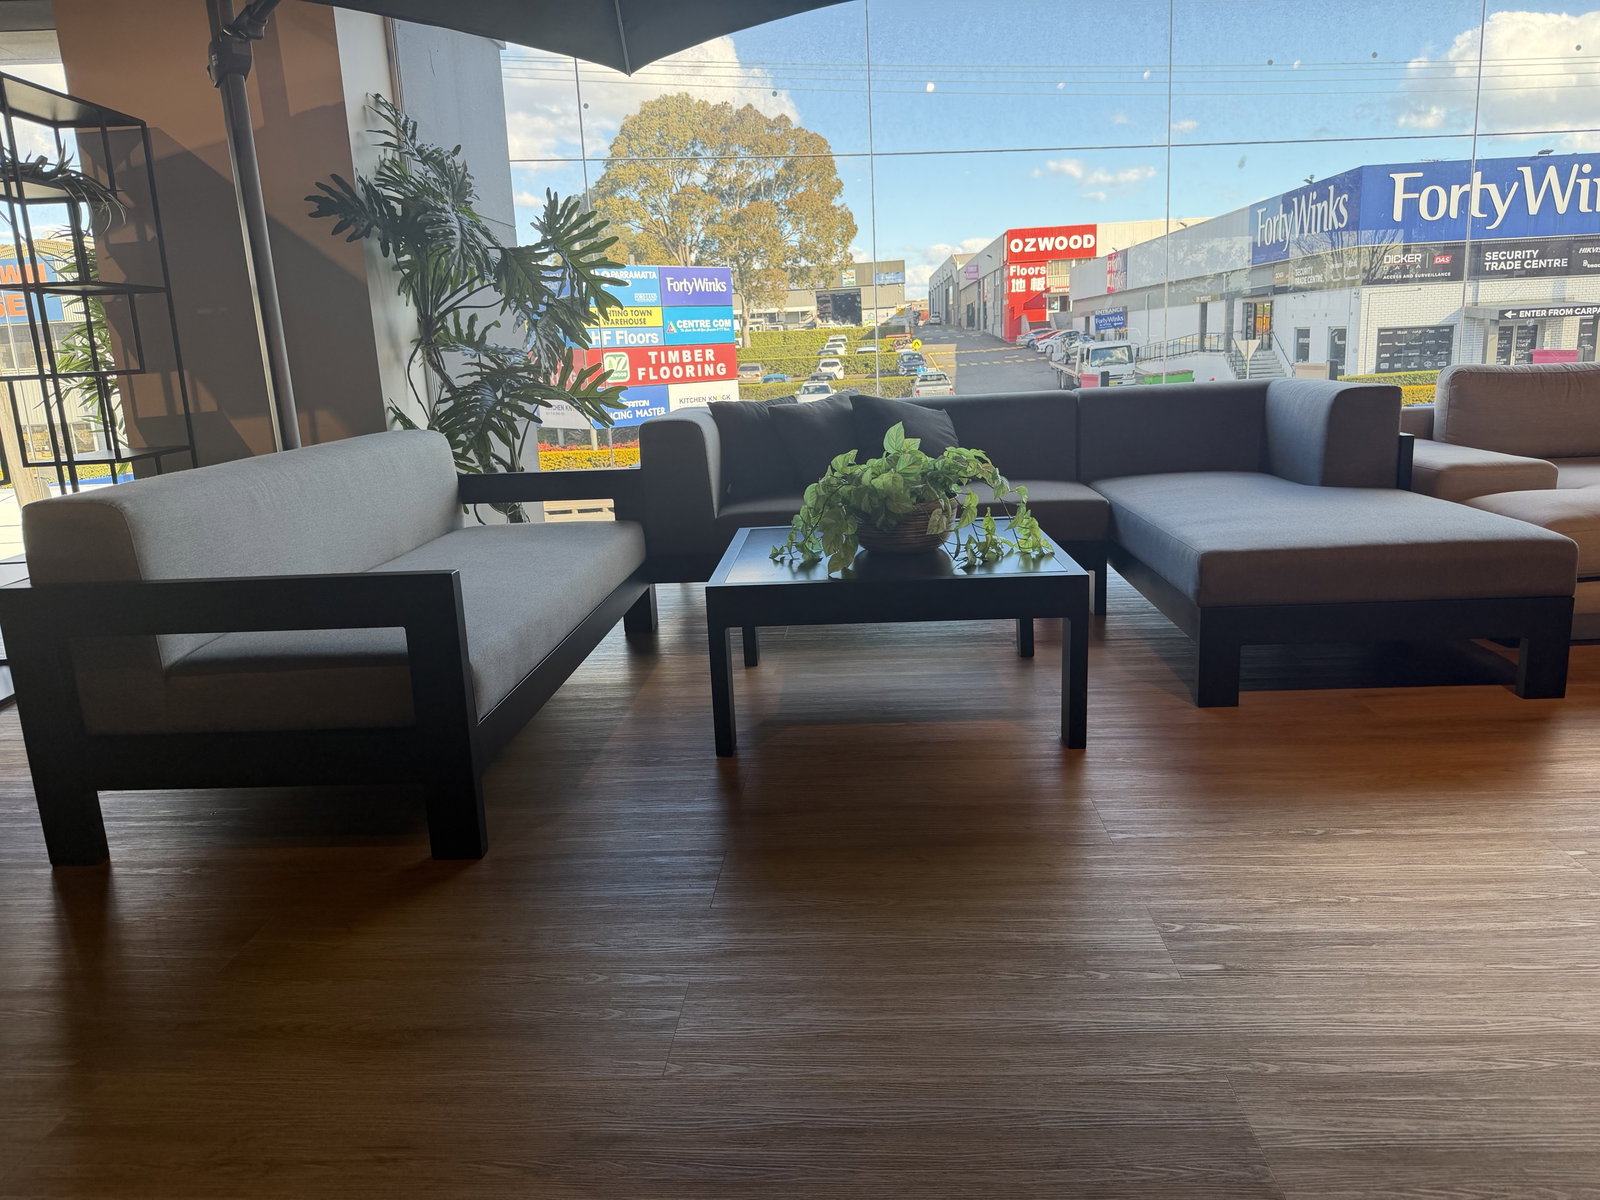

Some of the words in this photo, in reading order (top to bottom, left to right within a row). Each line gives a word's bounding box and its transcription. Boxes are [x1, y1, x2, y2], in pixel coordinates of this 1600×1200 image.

[1010, 234, 1096, 253] OZWOOD
[1383, 253, 1422, 264] DICKER
[1485, 249, 1539, 261] SECURITY
[1484, 260, 1521, 271] TRADE
[1524, 258, 1568, 269] CENTRE
[1010, 265, 1046, 276] Floors
[630, 309, 653, 317] TOWN
[1519, 309, 1547, 318] ENTER
[1548, 307, 1574, 316] FROM
[602, 317, 647, 326] WAREHOUSE
[676, 319, 711, 329] CENTRE
[712, 318, 732, 328] COM
[615, 329, 659, 345] Floors
[648, 349, 716, 365] TIMBER
[637, 363, 727, 381] FLOORING
[635, 407, 666, 418] MASTER
